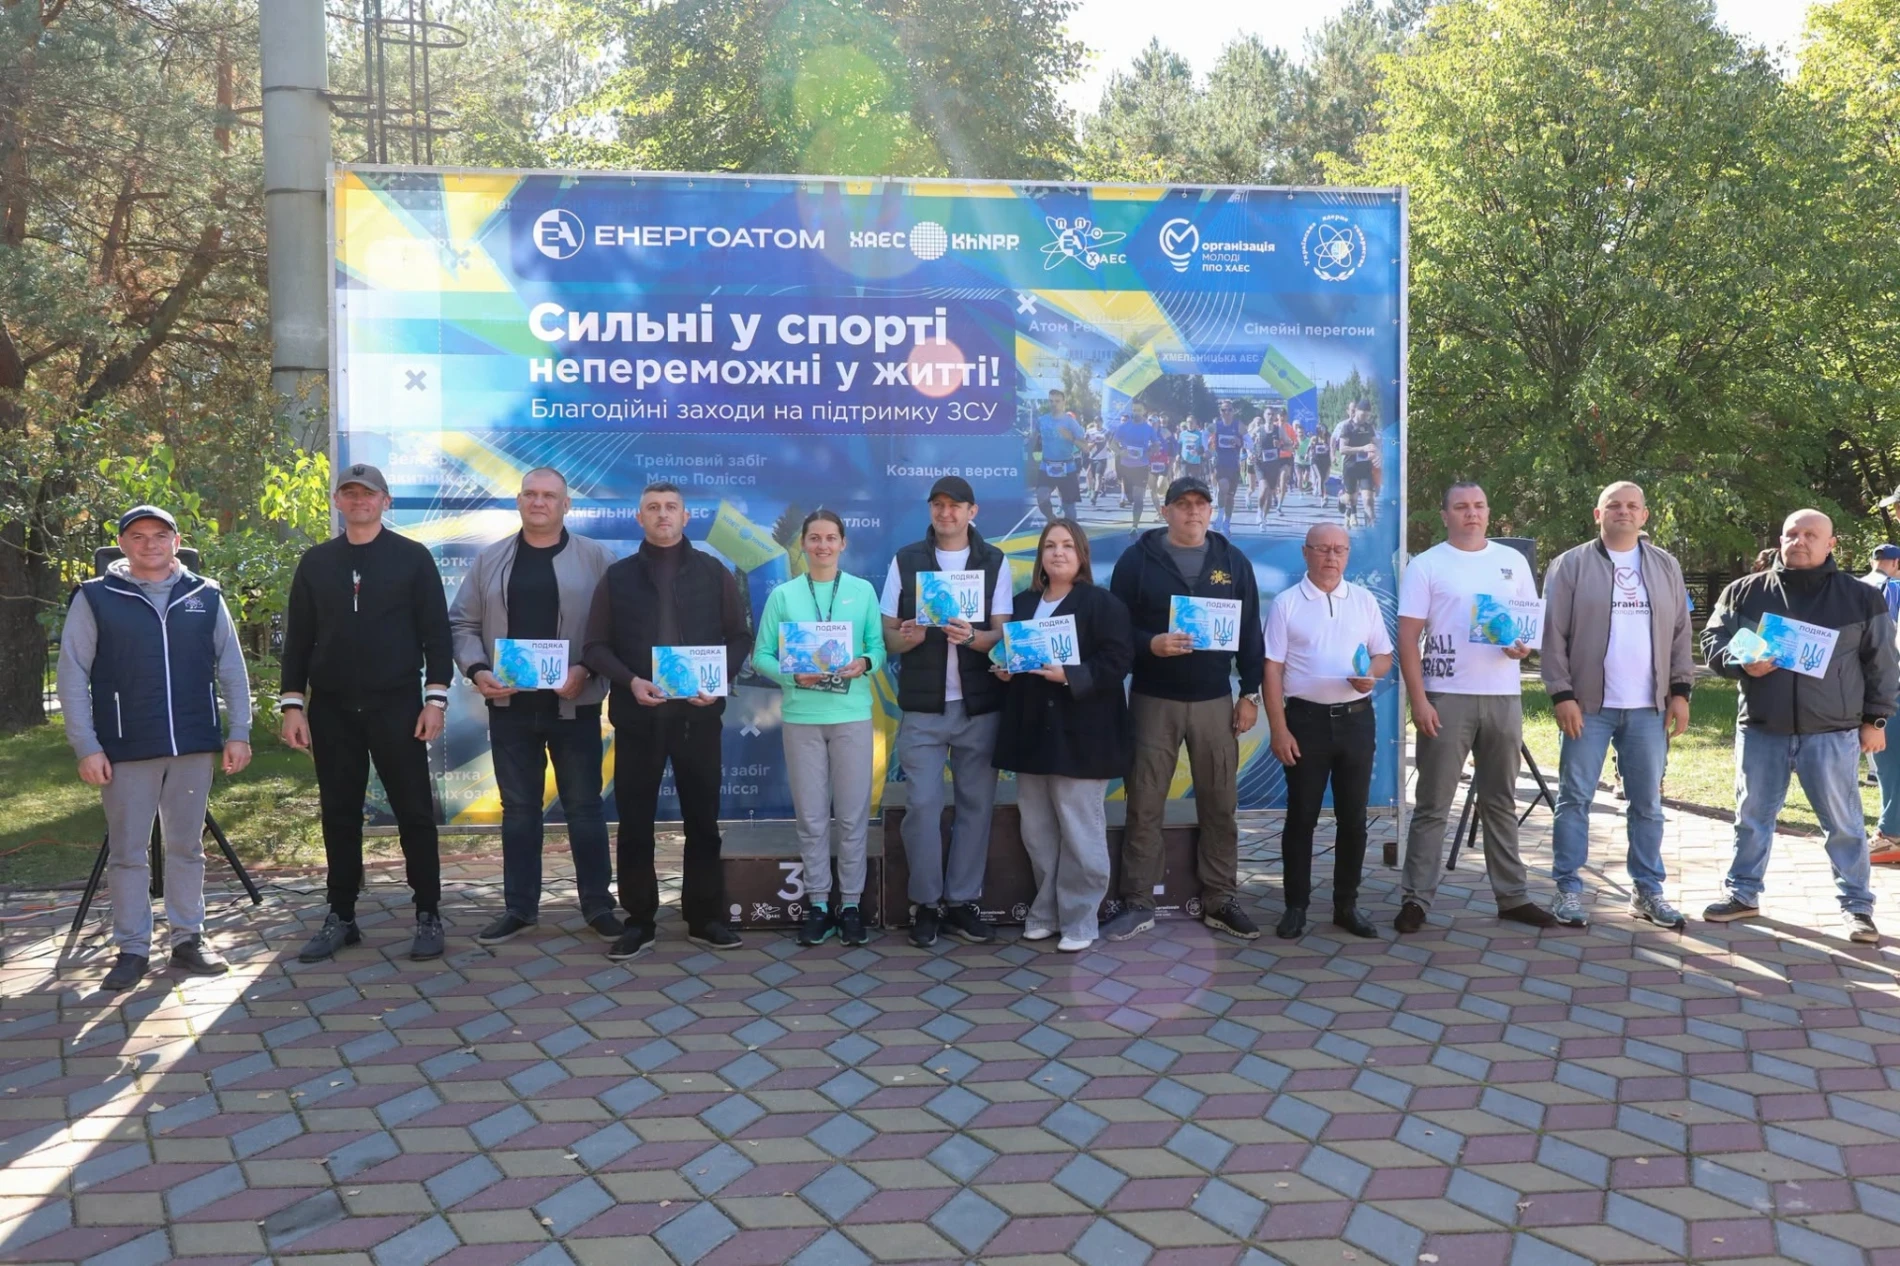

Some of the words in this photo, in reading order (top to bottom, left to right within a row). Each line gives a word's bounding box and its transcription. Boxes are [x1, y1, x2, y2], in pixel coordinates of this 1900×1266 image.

[595, 225, 825, 249] ЕНЕРГОАТОМ
[850, 231, 906, 249] ХАЕС
[1202, 240, 1276, 253] організація
[1086, 252, 1127, 266] ХАЕС
[1202, 253, 1241, 262] МОЛОДІ
[1202, 264, 1223, 272] ППО
[1225, 264, 1250, 273] ХАЕС
[528, 302, 713, 344] Сильні
[730, 313, 761, 350] у
[778, 306, 946, 353] спорті
[1028, 320, 1068, 333] Атом
[1244, 322, 1300, 336] Сімейні
[1304, 325, 1375, 338] перегони
[1162, 353, 1237, 364] ХМЕЛЬНИЦЬКА
[1240, 354, 1259, 363] АЕС
[529, 355, 820, 393] непереможні
[836, 363, 859, 392] у
[872, 357, 1000, 387] житті!
[530, 397, 669, 423] Благодійні
[676, 402, 765, 425] заходи
[774, 405, 803, 420] на
[811, 402, 939, 425] підтримку
[947, 402, 999, 422] ЗСУ
[634, 454, 727, 468] Трейловий
[729, 453, 767, 467] забіг
[886, 464, 960, 479] Козацька
[965, 467, 1018, 478] верста
[646, 474, 688, 486] Мале
[693, 473, 756, 486] Полісся
[950, 573, 980, 581] ПОДЯКА
[1206, 601, 1236, 609] ПОДЯКА
[1508, 599, 1541, 608] ПОДЯКА
[1039, 618, 1070, 628] ПОДЯКА
[1799, 625, 1832, 638] ПОДЯКА
[731, 763, 771, 777] забіг
[777, 862, 804, 901] 3
